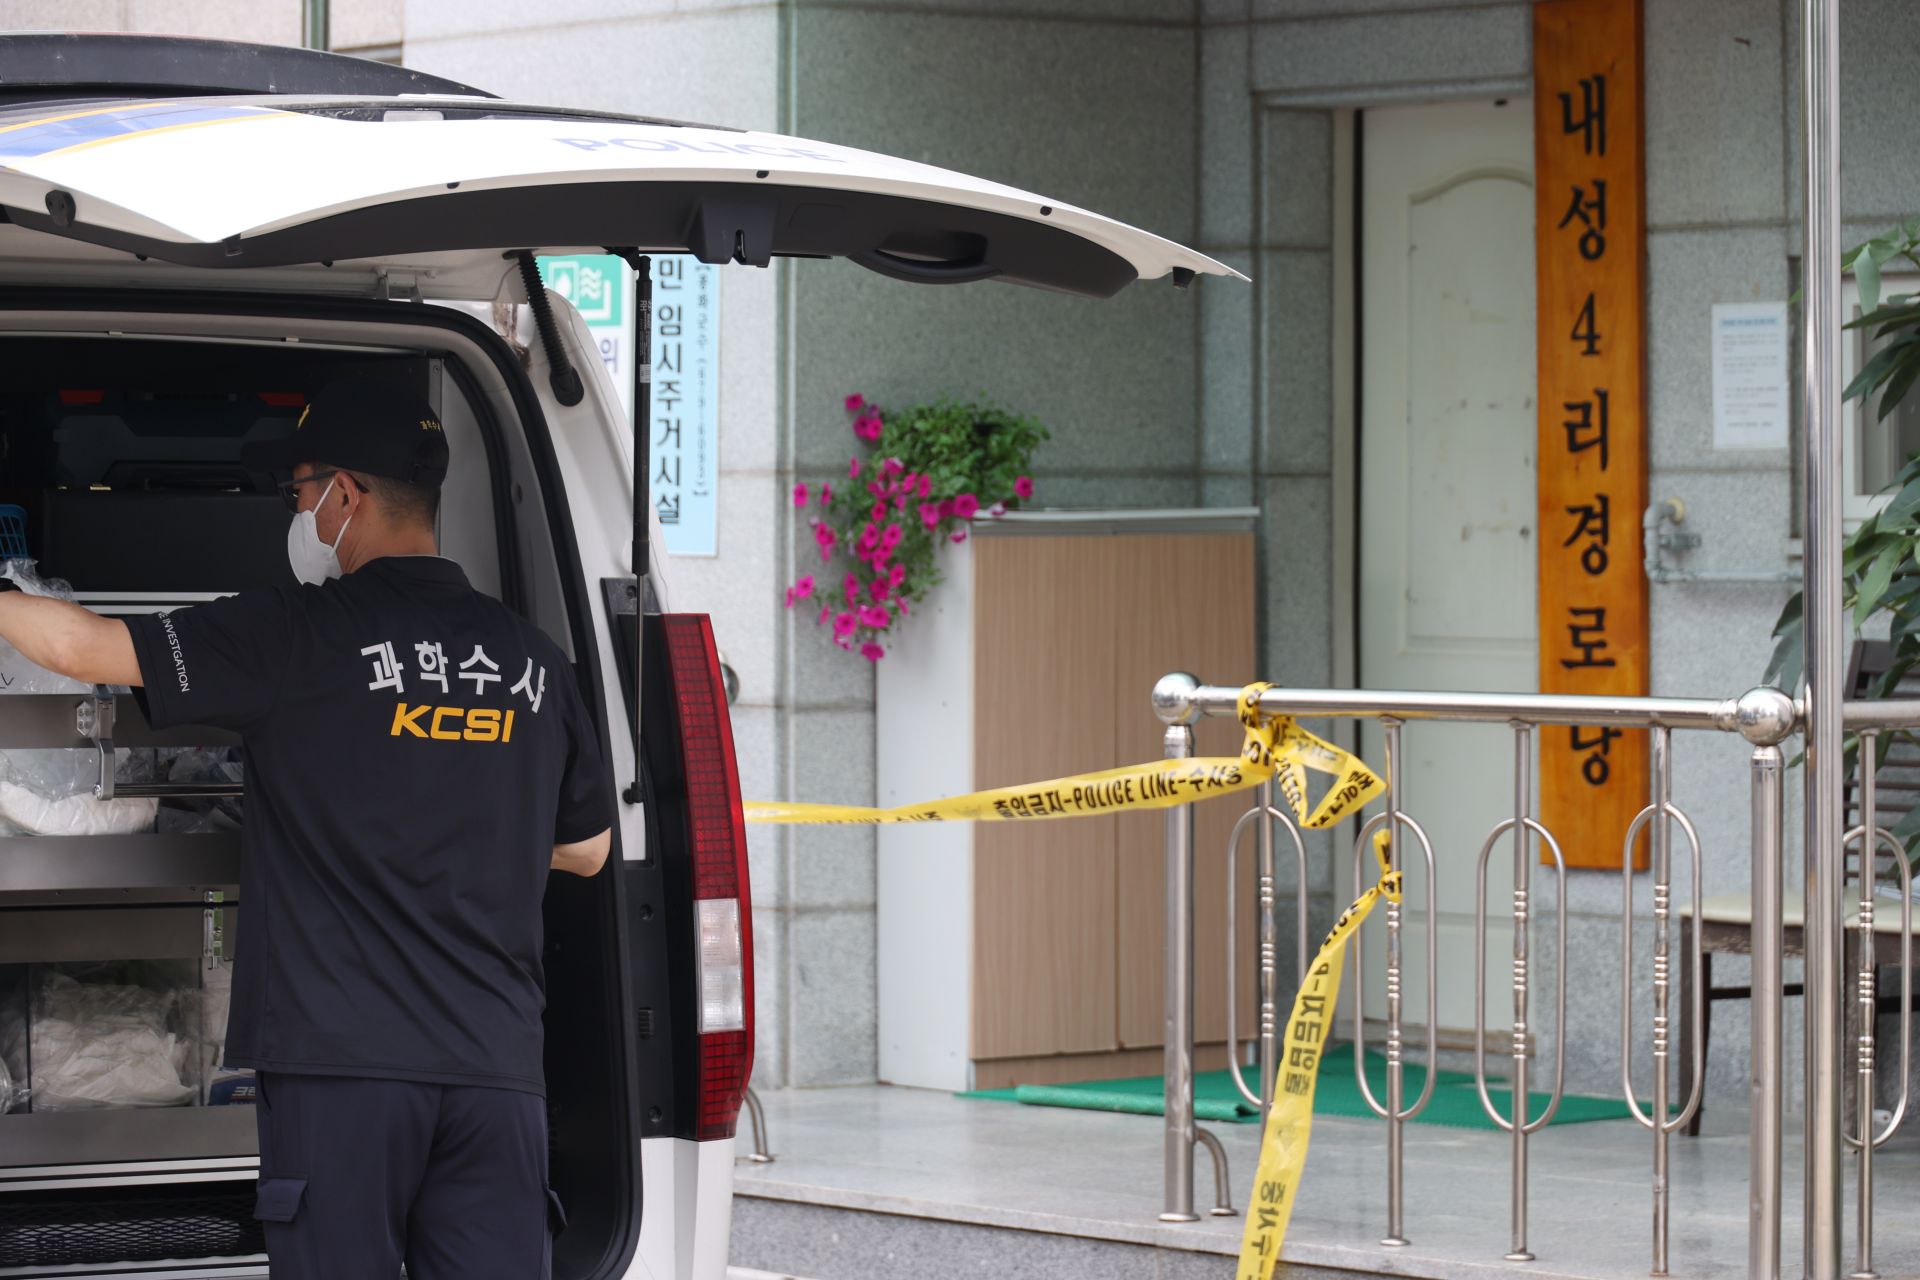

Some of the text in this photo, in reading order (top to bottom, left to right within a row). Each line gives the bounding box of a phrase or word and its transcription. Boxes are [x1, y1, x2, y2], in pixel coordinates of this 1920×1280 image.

[551, 137, 850, 163] POLICE
[655, 304, 683, 525] 임시주거시설
[162, 618, 190, 692] INVESTGATION
[360, 640, 546, 714] 과학수사
[390, 702, 515, 743] KCSI
